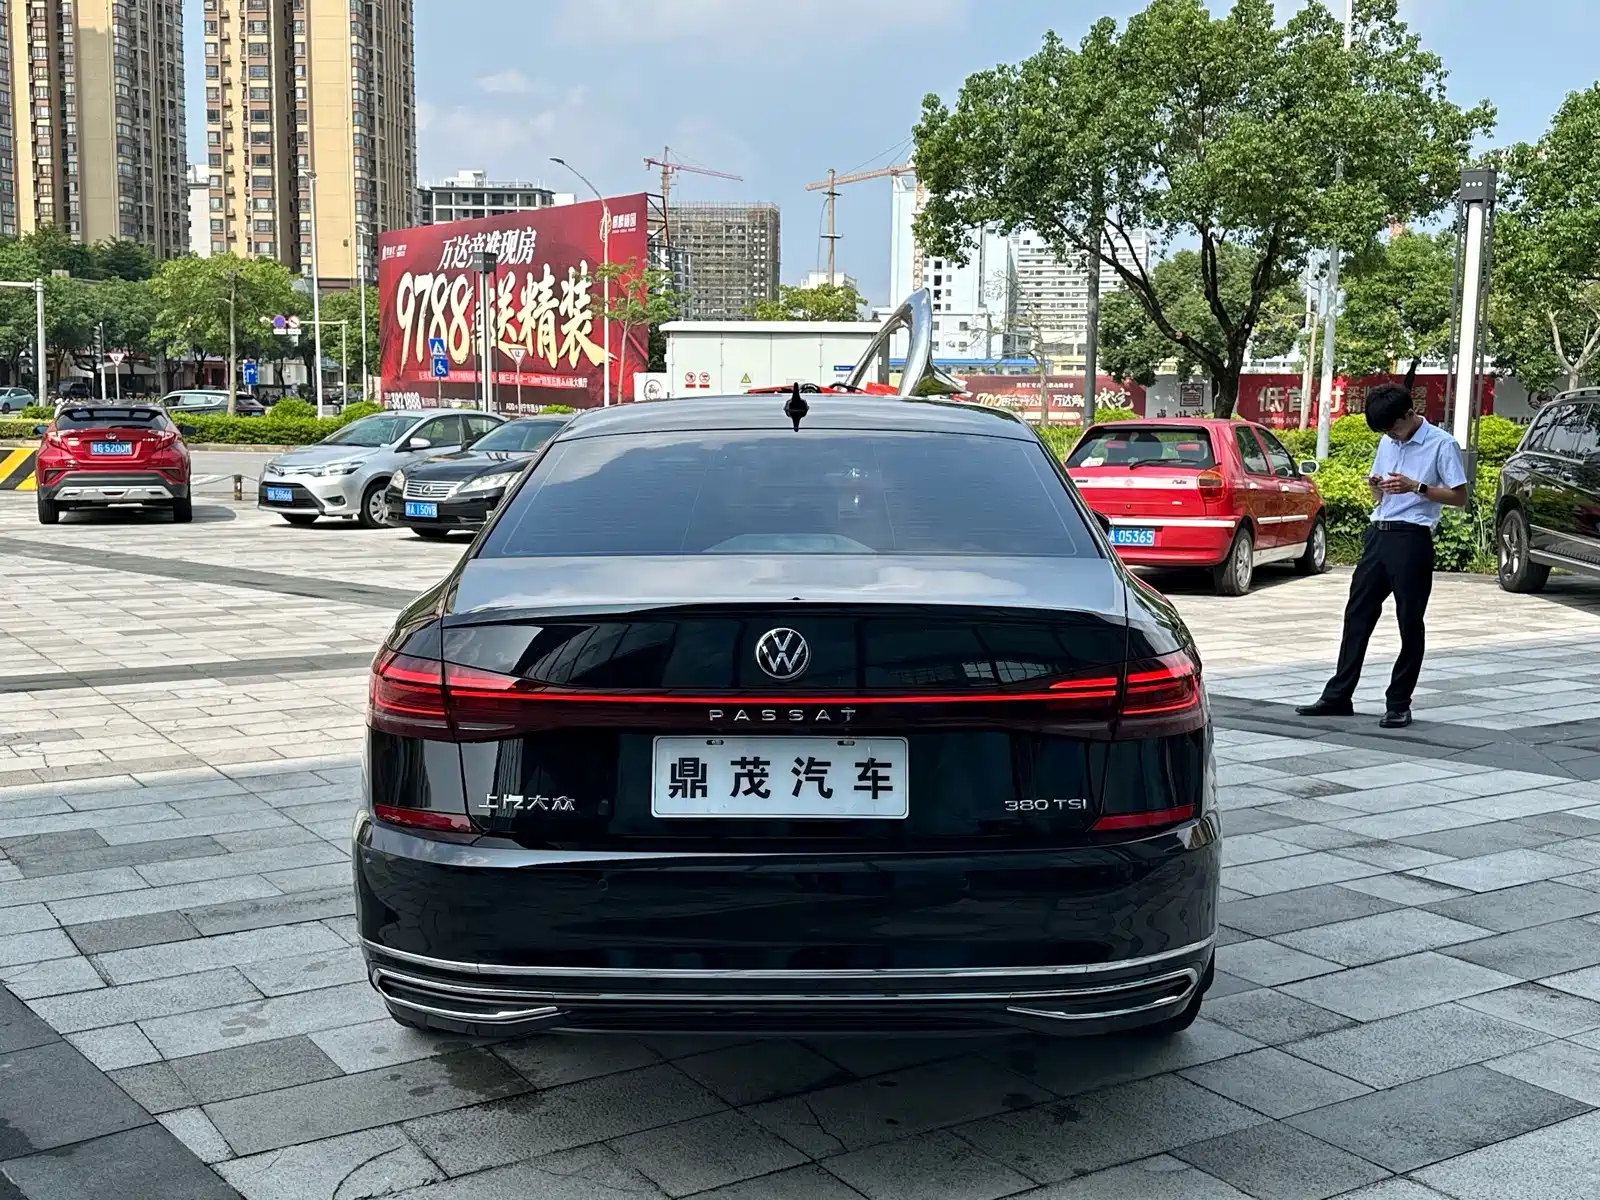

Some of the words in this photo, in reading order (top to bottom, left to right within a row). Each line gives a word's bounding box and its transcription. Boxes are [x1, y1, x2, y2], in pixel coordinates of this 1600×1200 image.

[708, 708, 857, 722] PASSAT
[668, 756, 894, 800] 鼎茂汽车
[478, 793, 576, 811] 上汽大众
[1004, 799, 1049, 811] 380
[1053, 798, 1087, 810] TSI
